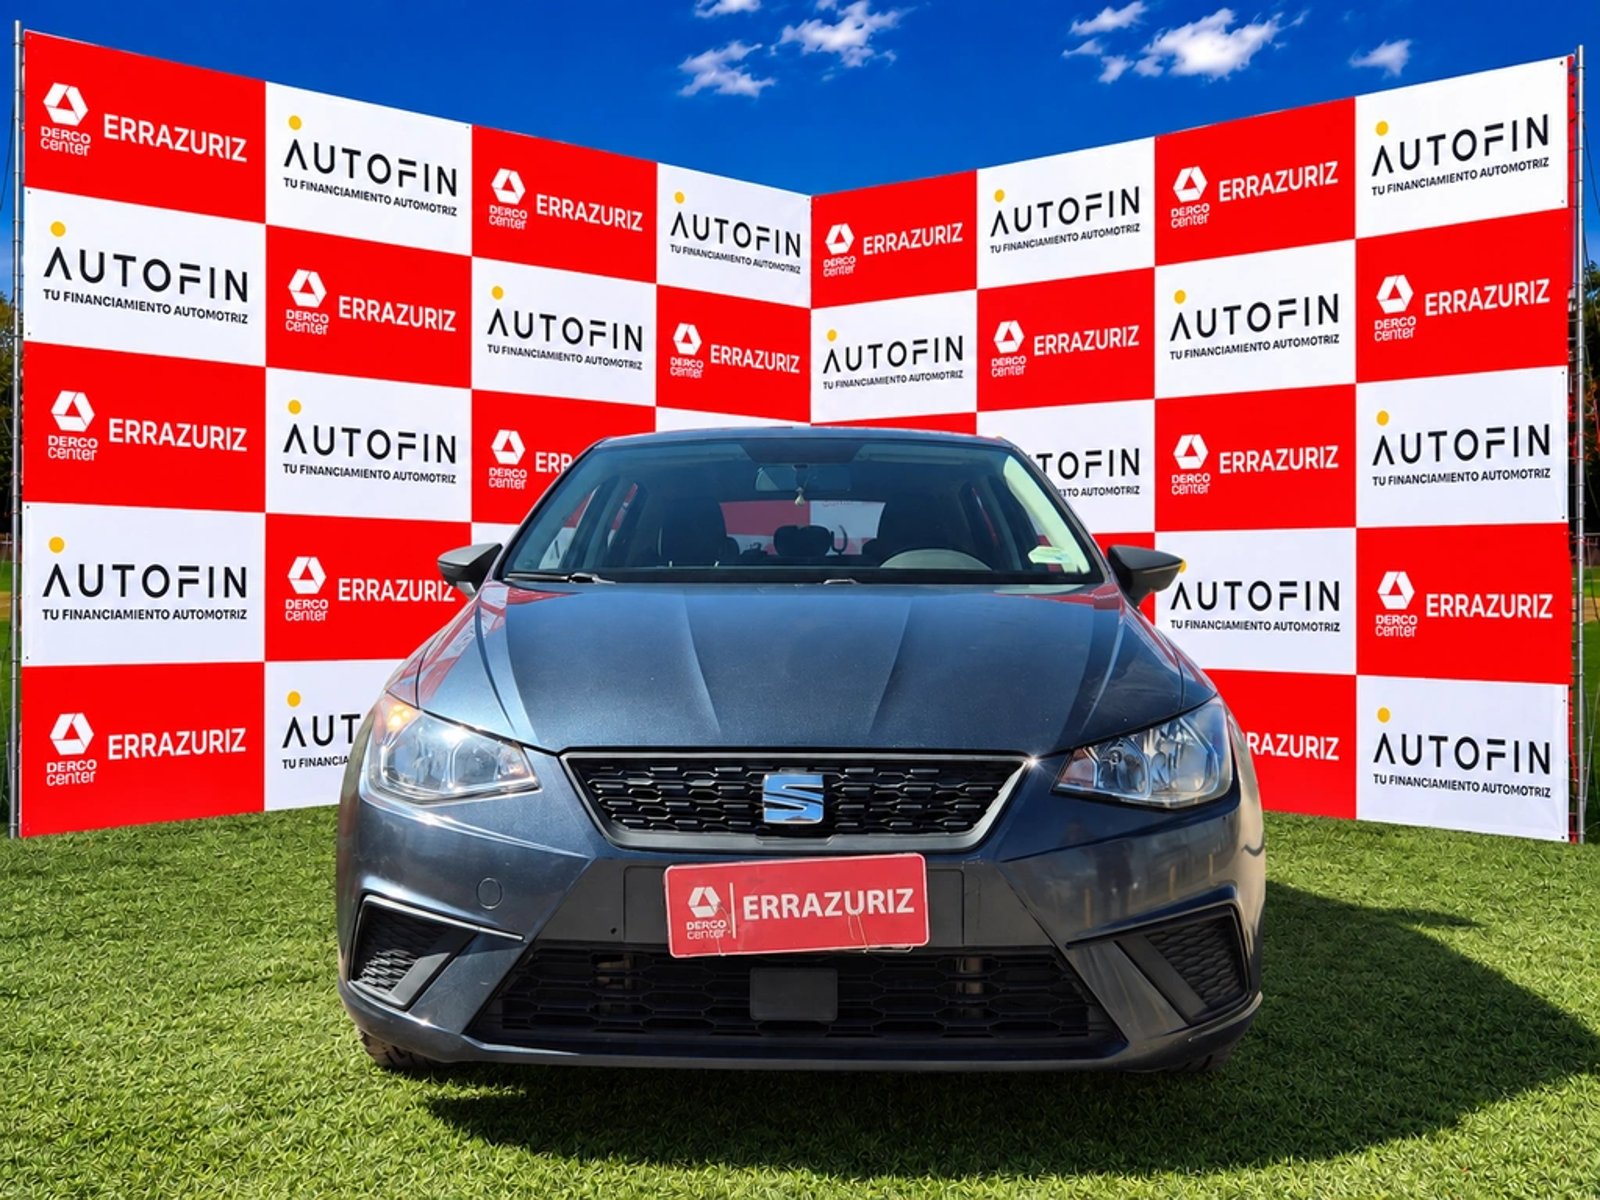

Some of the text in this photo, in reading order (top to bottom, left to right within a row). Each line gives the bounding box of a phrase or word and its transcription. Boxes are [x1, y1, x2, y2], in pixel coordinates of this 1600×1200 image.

[41, 125, 91, 144] DERCO
[104, 114, 247, 162] ERRAZURIZ
[1372, 114, 1548, 176] AUTOFIN
[41, 138, 90, 156] center
[284, 139, 456, 196] AUTOFIN
[1372, 157, 1549, 195] TU FINANCIAMIENTO AUTOMOTRIZ
[1219, 161, 1338, 202] ERRAZURIZ
[284, 178, 457, 216] TU FINANCIAMIENTO AUTOMOTRIZ
[490, 204, 527, 219] DERCO
[537, 194, 642, 231] ERRAZURIZ
[991, 186, 1139, 237] AUTOFIN
[1171, 202, 1210, 217] DERCO
[489, 215, 526, 229] center
[1171, 214, 1209, 228] center
[671, 212, 800, 258] AUTOFIN
[864, 223, 962, 255] ERRAZURIZ
[991, 223, 1140, 253] TU FINANCIAMIENTO AUTOMOTRIZ
[671, 244, 800, 274] TU FINANCIAMIENTO AUTOMOTRIZ
[823, 254, 856, 268] DERCO
[44, 247, 247, 302] AUTOFIN
[824, 265, 855, 277] center
[43, 289, 248, 324] TU FINANCIAMIENTO AUTOMOTRIZ
[1426, 279, 1550, 316] ERRAZURIZ
[286, 309, 329, 324] DERCO
[339, 296, 456, 331] ERRAZURIZ
[1170, 294, 1338, 341] AUTOFIN
[1375, 316, 1416, 330] DERCO
[286, 320, 328, 334] center
[488, 309, 642, 352] AUTOFIN
[1375, 327, 1414, 341] center
[1034, 325, 1139, 356] ERRAZURIZ
[1170, 334, 1339, 359] TU FINANCIAMIENTO AUTOMOTRIZ
[488, 344, 642, 370] TU FINANCIAMIENTO AUTOMOTRIZ
[671, 357, 703, 369] DERCO
[711, 345, 799, 373] ERRAZURIZ
[823, 336, 962, 374] AUTOFIN
[992, 356, 1026, 367] DERCO
[670, 366, 702, 378] center
[836, 375, 907, 387] FINANCIAMIENTO
[909, 370, 963, 382] AUTOMOTRIZ
[992, 365, 1025, 377] center
[48, 435, 98, 448] DERCO
[109, 418, 247, 451] ERRAZURIZ
[283, 424, 455, 464] AUTOFIN
[1373, 424, 1549, 466] AUTOFIN
[48, 447, 97, 461] center
[1028, 448, 1139, 480] TOFIN
[1220, 446, 1338, 473] ERRAZURIZ
[283, 464, 456, 484] TU FINANCIAMIENTO AUTOMOTRIZ
[489, 468, 527, 479] DERCO
[489, 477, 526, 489] center
[1172, 473, 1210, 484] DERCO
[1373, 468, 1550, 486] TU FINANCIAMIENTO AUTOMOTRIZ
[1081, 486, 1140, 496] AUTOMOTRIZ
[1172, 483, 1210, 495] center
[43, 564, 246, 598] AUTOFIN
[339, 578, 456, 601] ERRAZURIZ
[286, 599, 328, 609] DERCO
[1171, 581, 1339, 611] AUTOFIN
[1427, 594, 1552, 618] ERRAZURIZ
[42, 609, 247, 620] TU FINANCIAMIENTO AUTOMOTRIZ
[285, 609, 327, 621] center
[1376, 615, 1417, 626] DERCO
[1171, 620, 1340, 632] TU FINANCIAMIENTO AUTOMOTRIZ
[1376, 625, 1416, 637] center
[109, 728, 246, 760] ERRAZURIZ
[1243, 731, 1340, 761] RAZURIZ
[1374, 733, 1550, 774] AUTOFIN
[47, 759, 97, 773] DERCO
[282, 756, 348, 769] TU FINANCIA
[47, 771, 96, 786] center
[1374, 774, 1551, 798] TU FINANCIAMIENTO AUTOMOTRIZ
[743, 888, 914, 921] ERRAZURIZ
[687, 921, 726, 930] DERCO
[687, 929, 727, 940] center
